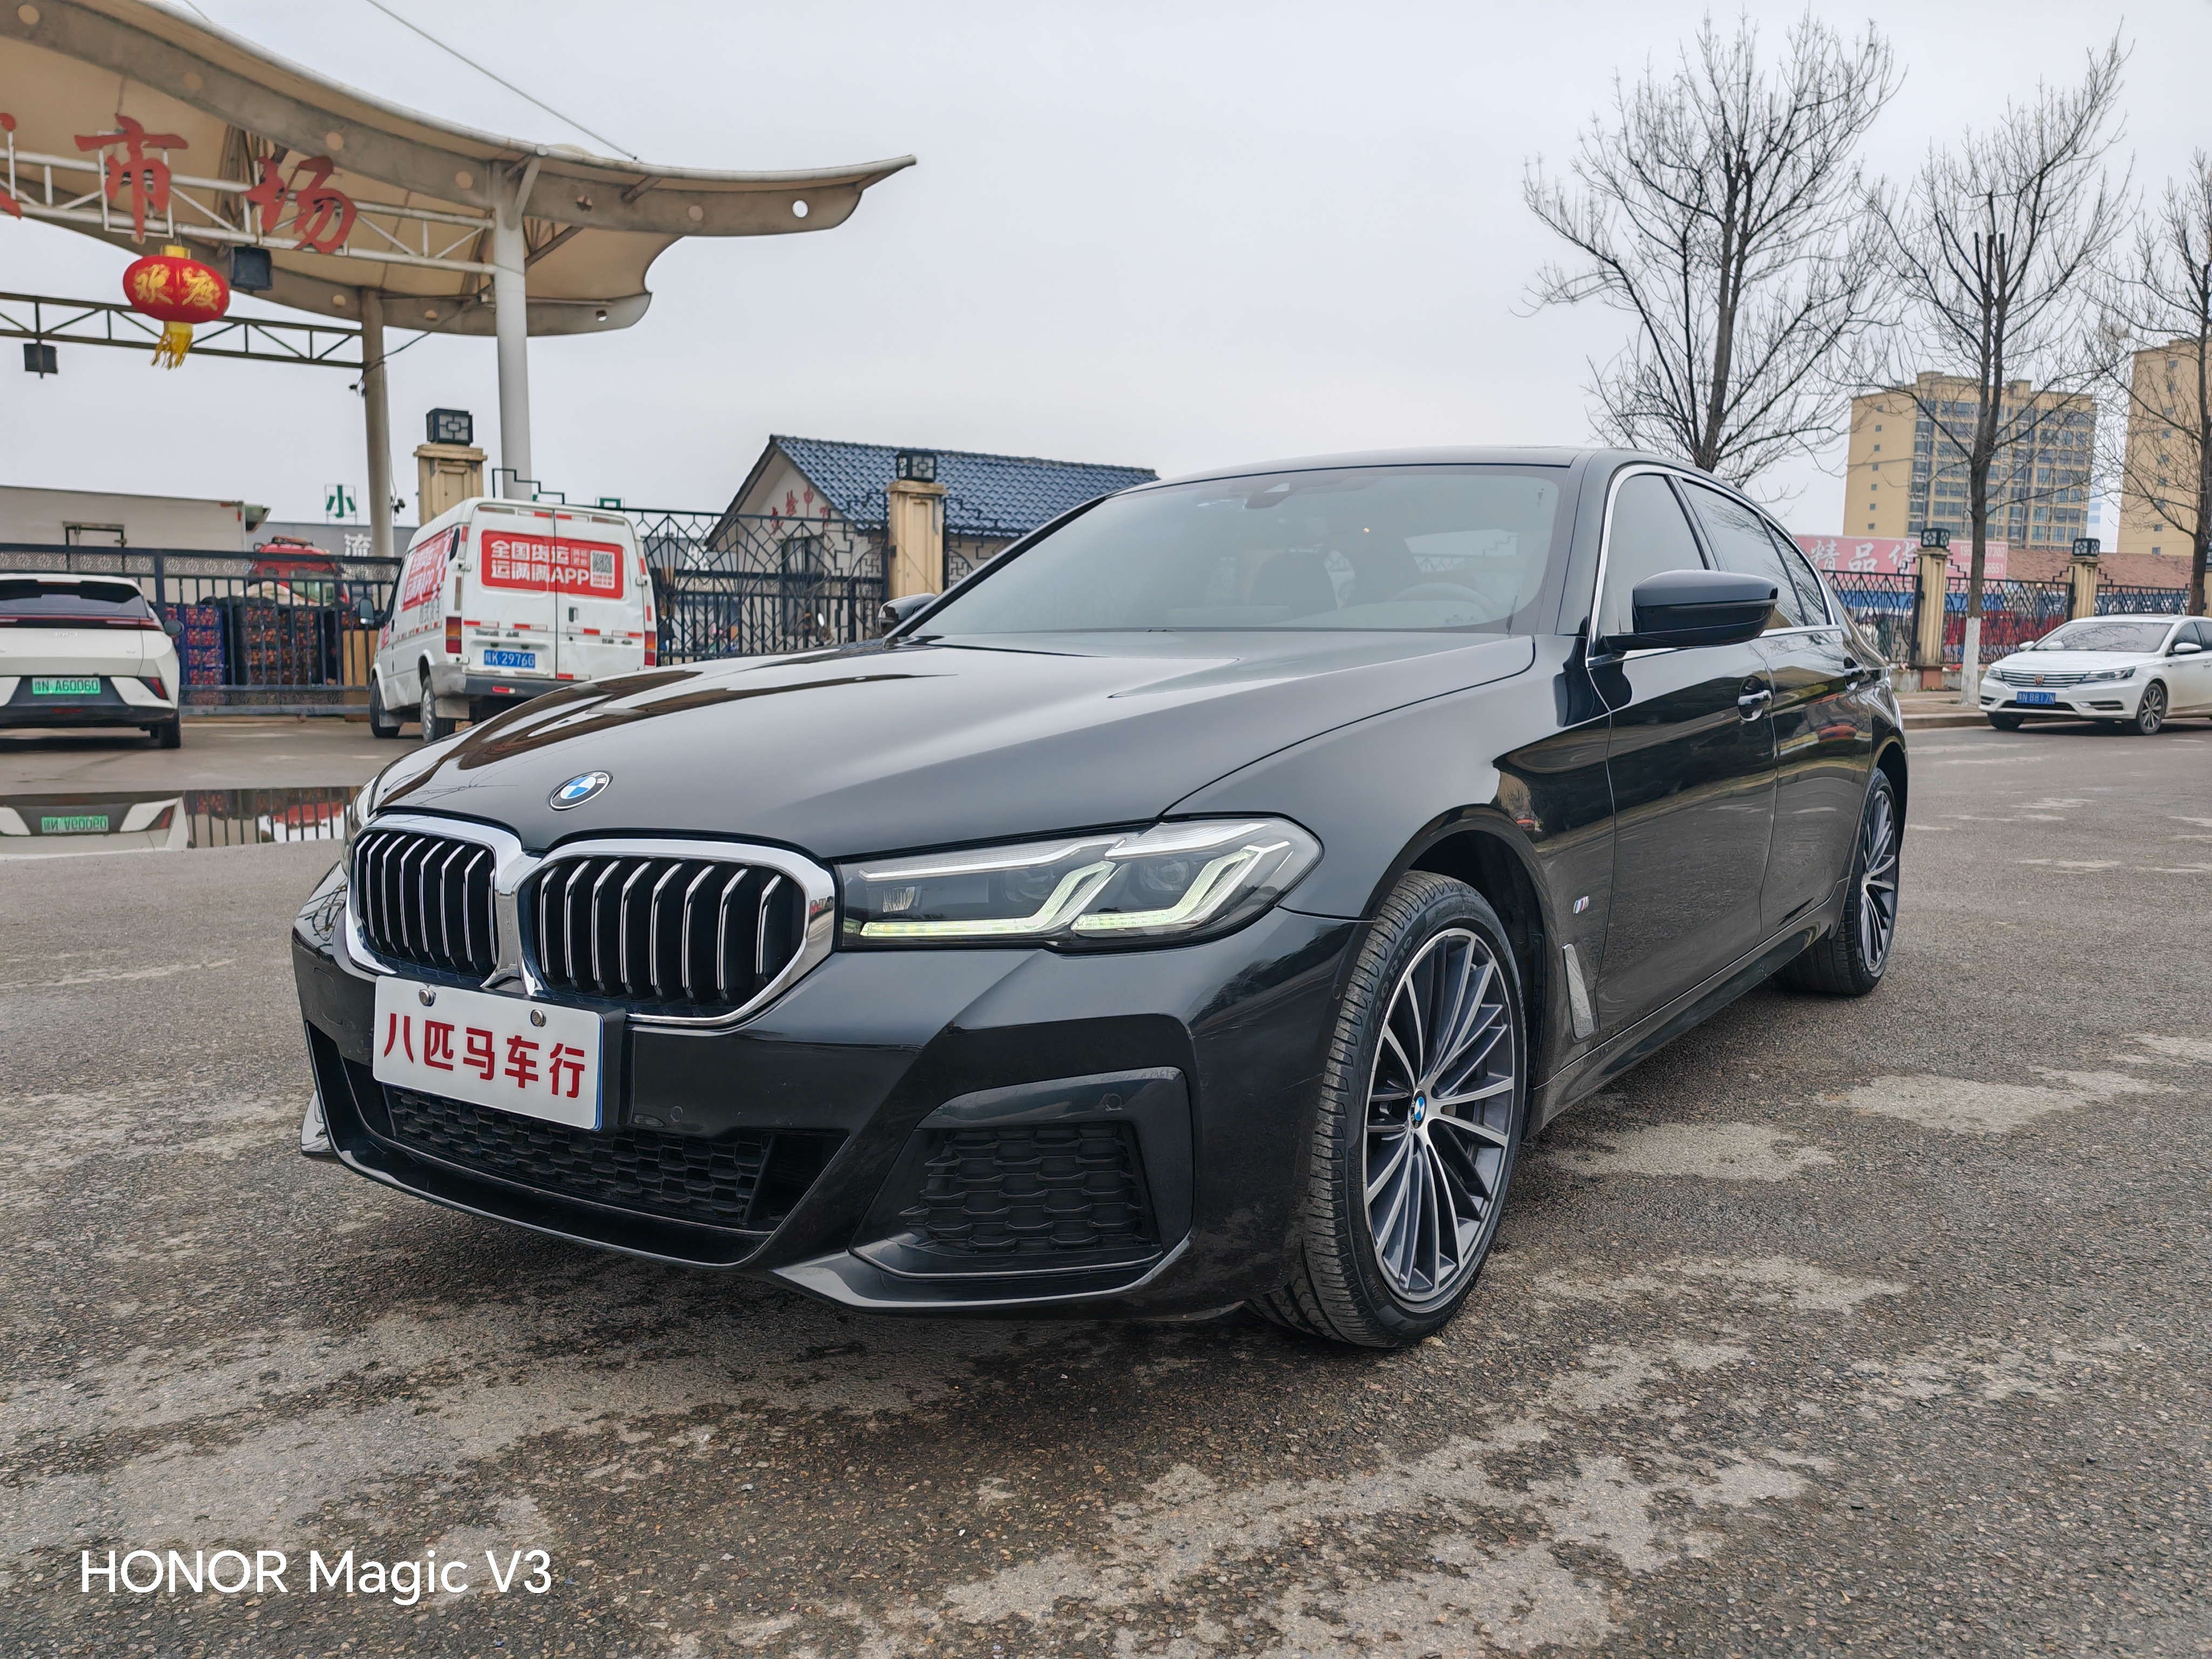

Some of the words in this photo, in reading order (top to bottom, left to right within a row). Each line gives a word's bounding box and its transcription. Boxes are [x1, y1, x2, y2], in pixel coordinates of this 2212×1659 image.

[0, 112, 356, 254] 市场
[326, 484, 356, 518] 小
[490, 539, 570, 565] 全国货运
[491, 559, 590, 585] 运满满APP
[383, 1013, 585, 1098] 八匹马车行
